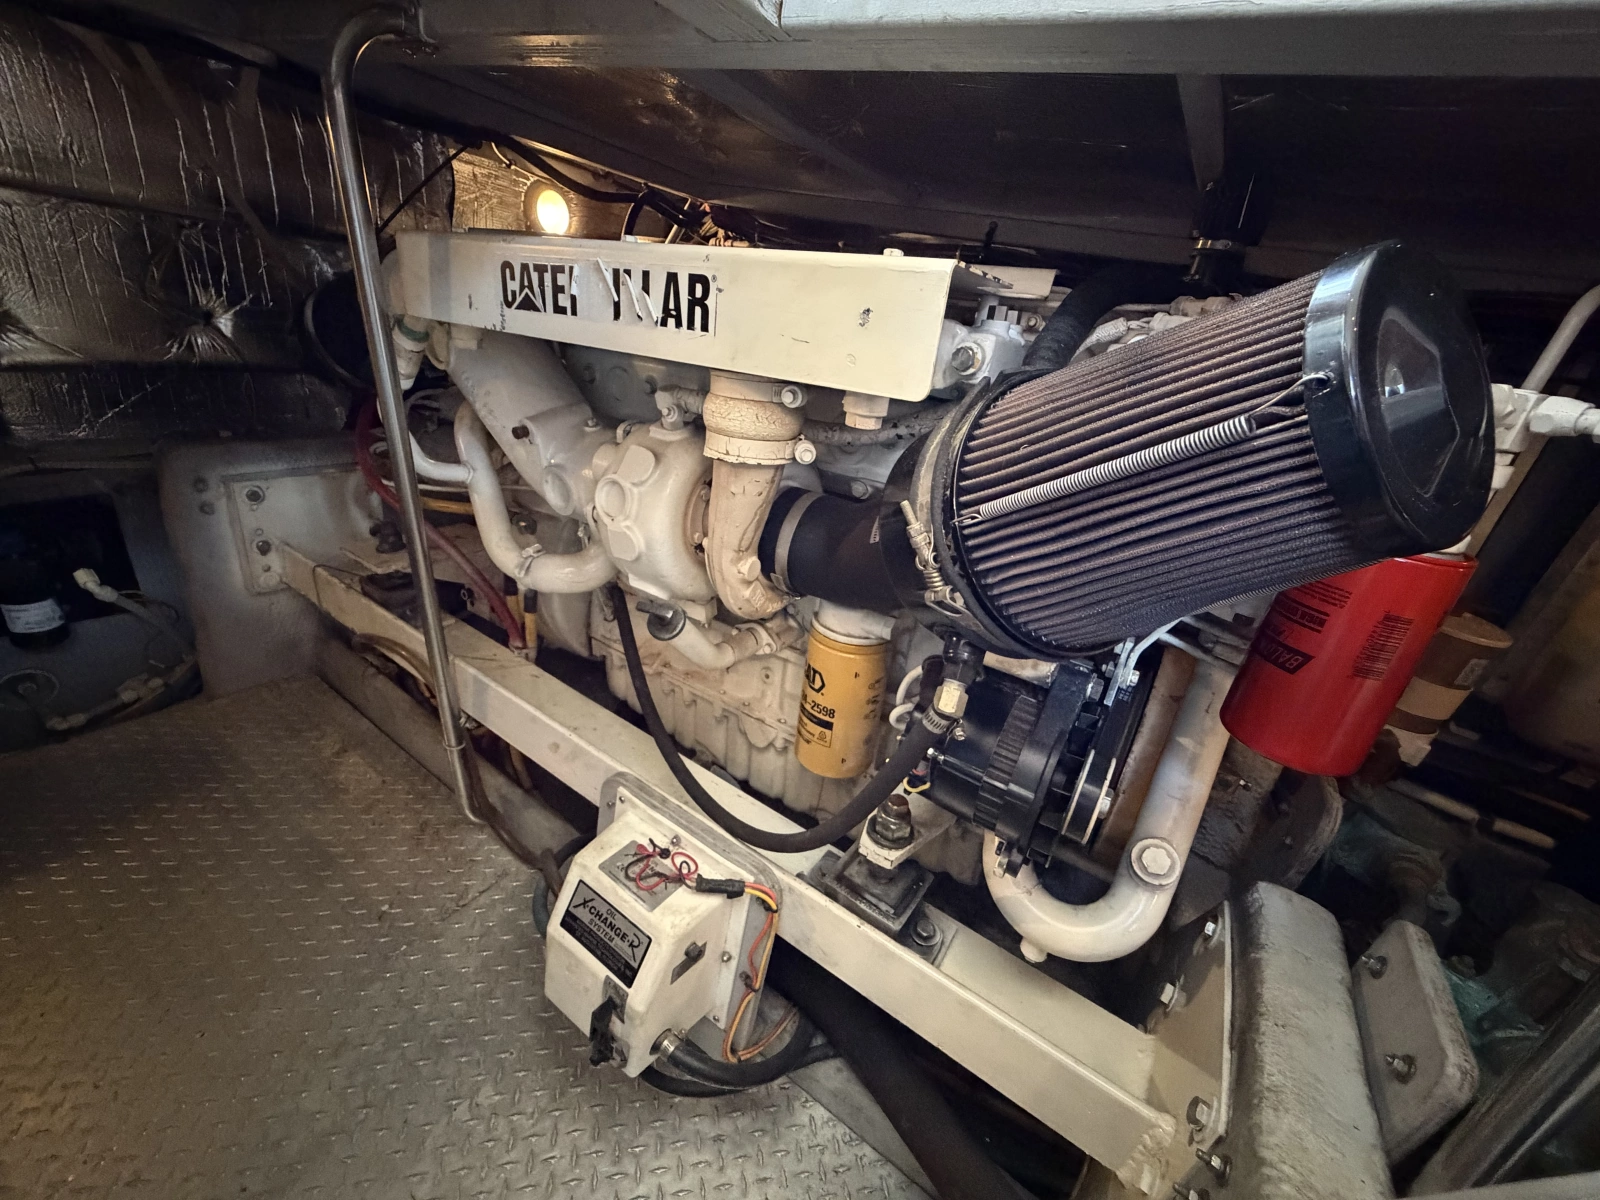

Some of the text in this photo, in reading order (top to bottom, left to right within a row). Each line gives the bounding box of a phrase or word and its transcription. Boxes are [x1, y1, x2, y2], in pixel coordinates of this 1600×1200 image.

[501, 260, 711, 333] CATEIAR
[605, 908, 617, 921] OIL
[587, 918, 616, 944] SYSTEM
